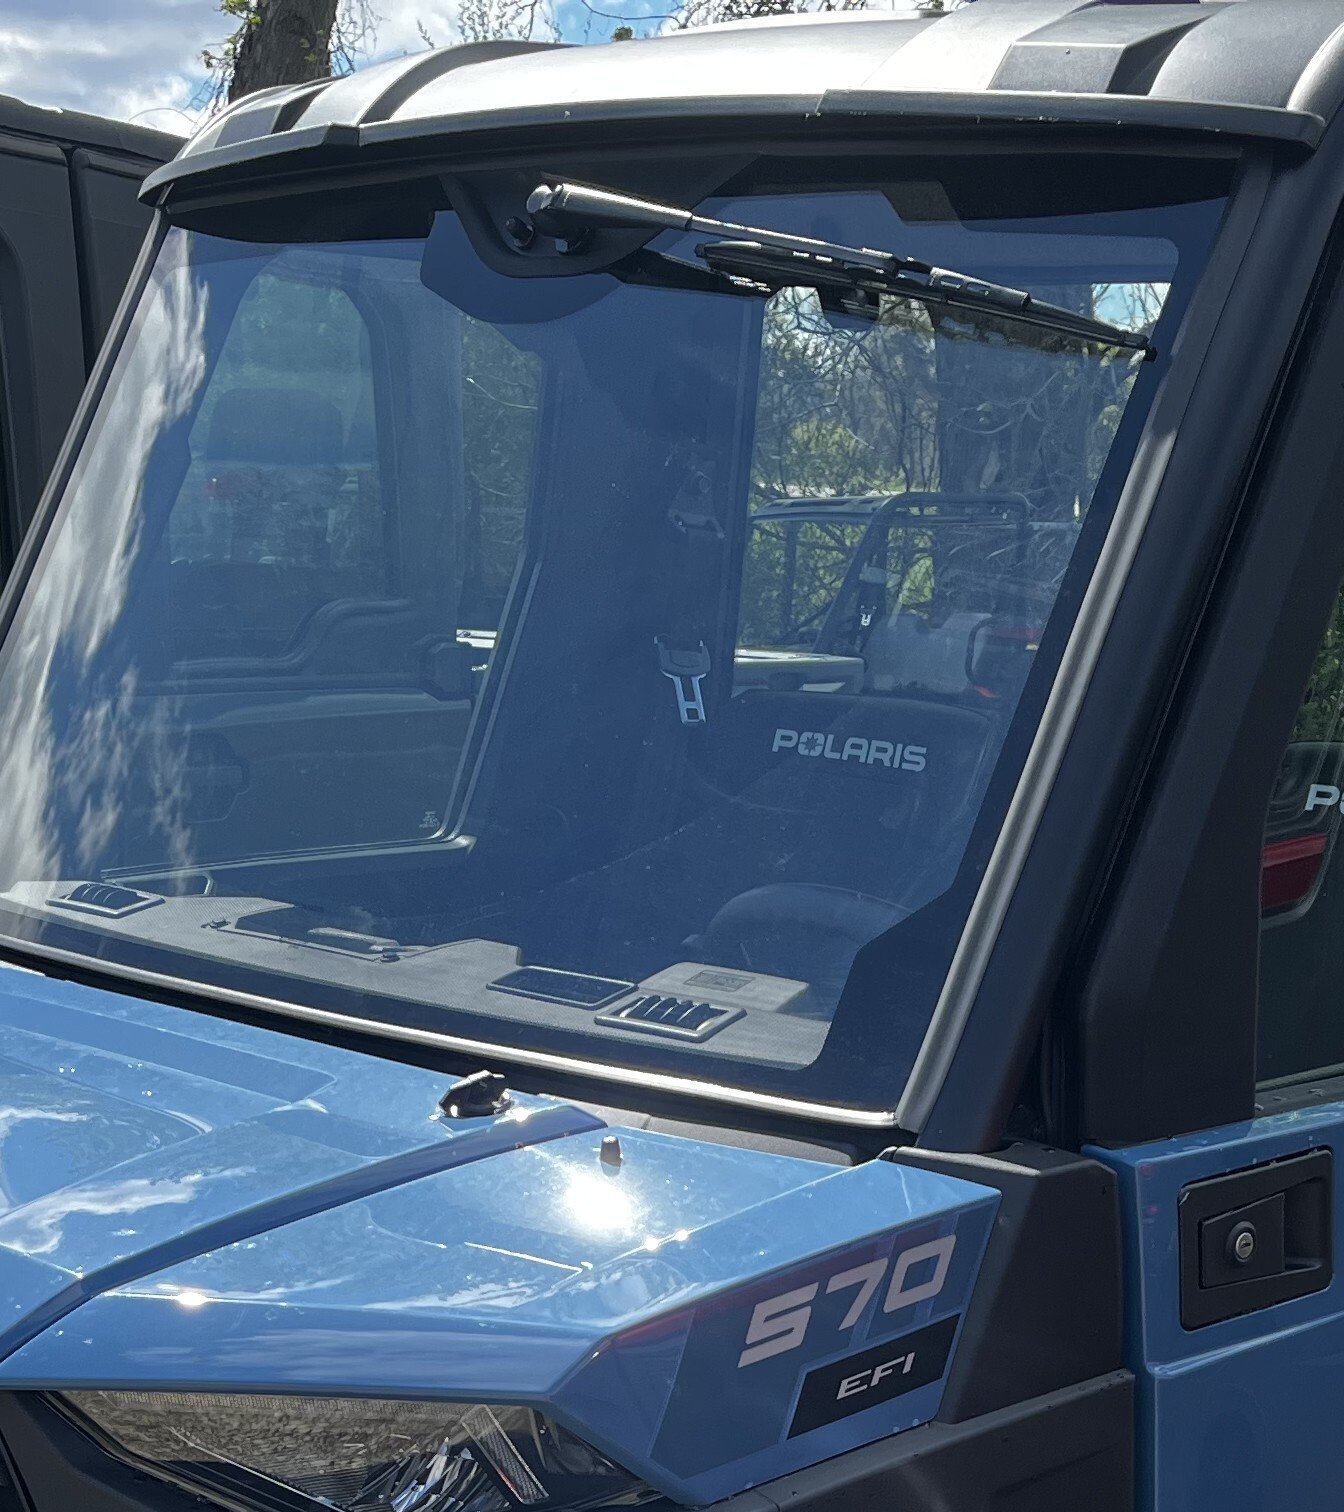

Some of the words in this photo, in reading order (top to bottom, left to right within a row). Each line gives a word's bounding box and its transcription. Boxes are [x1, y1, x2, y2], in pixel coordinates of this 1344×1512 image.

[771, 728, 928, 772] POLARIS
[736, 1234, 957, 1369] 570
[836, 1351, 916, 1401] EFI
